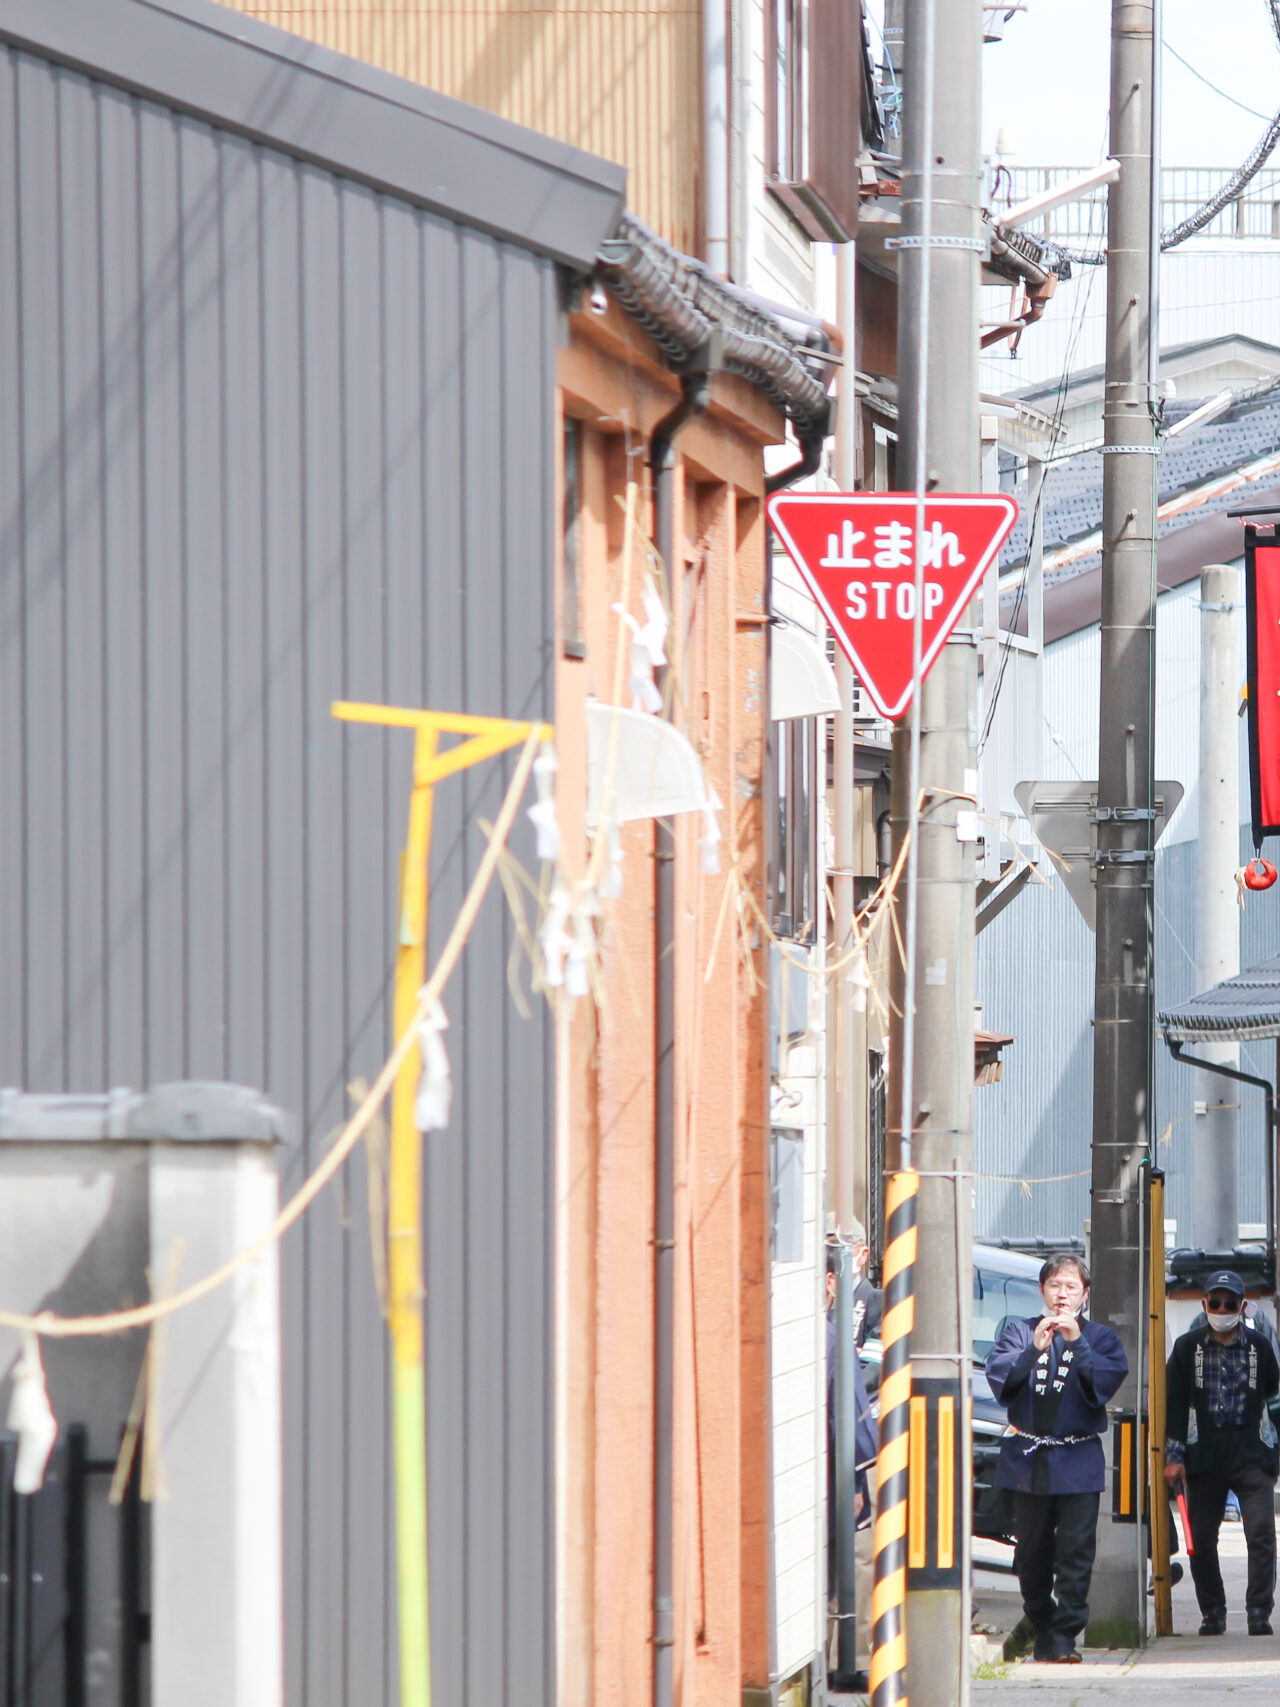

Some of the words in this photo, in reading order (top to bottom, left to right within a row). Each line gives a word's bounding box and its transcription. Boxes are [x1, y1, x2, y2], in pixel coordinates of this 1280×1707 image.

[820, 520, 966, 569] 止まれ
[846, 581, 944, 620] STOP
